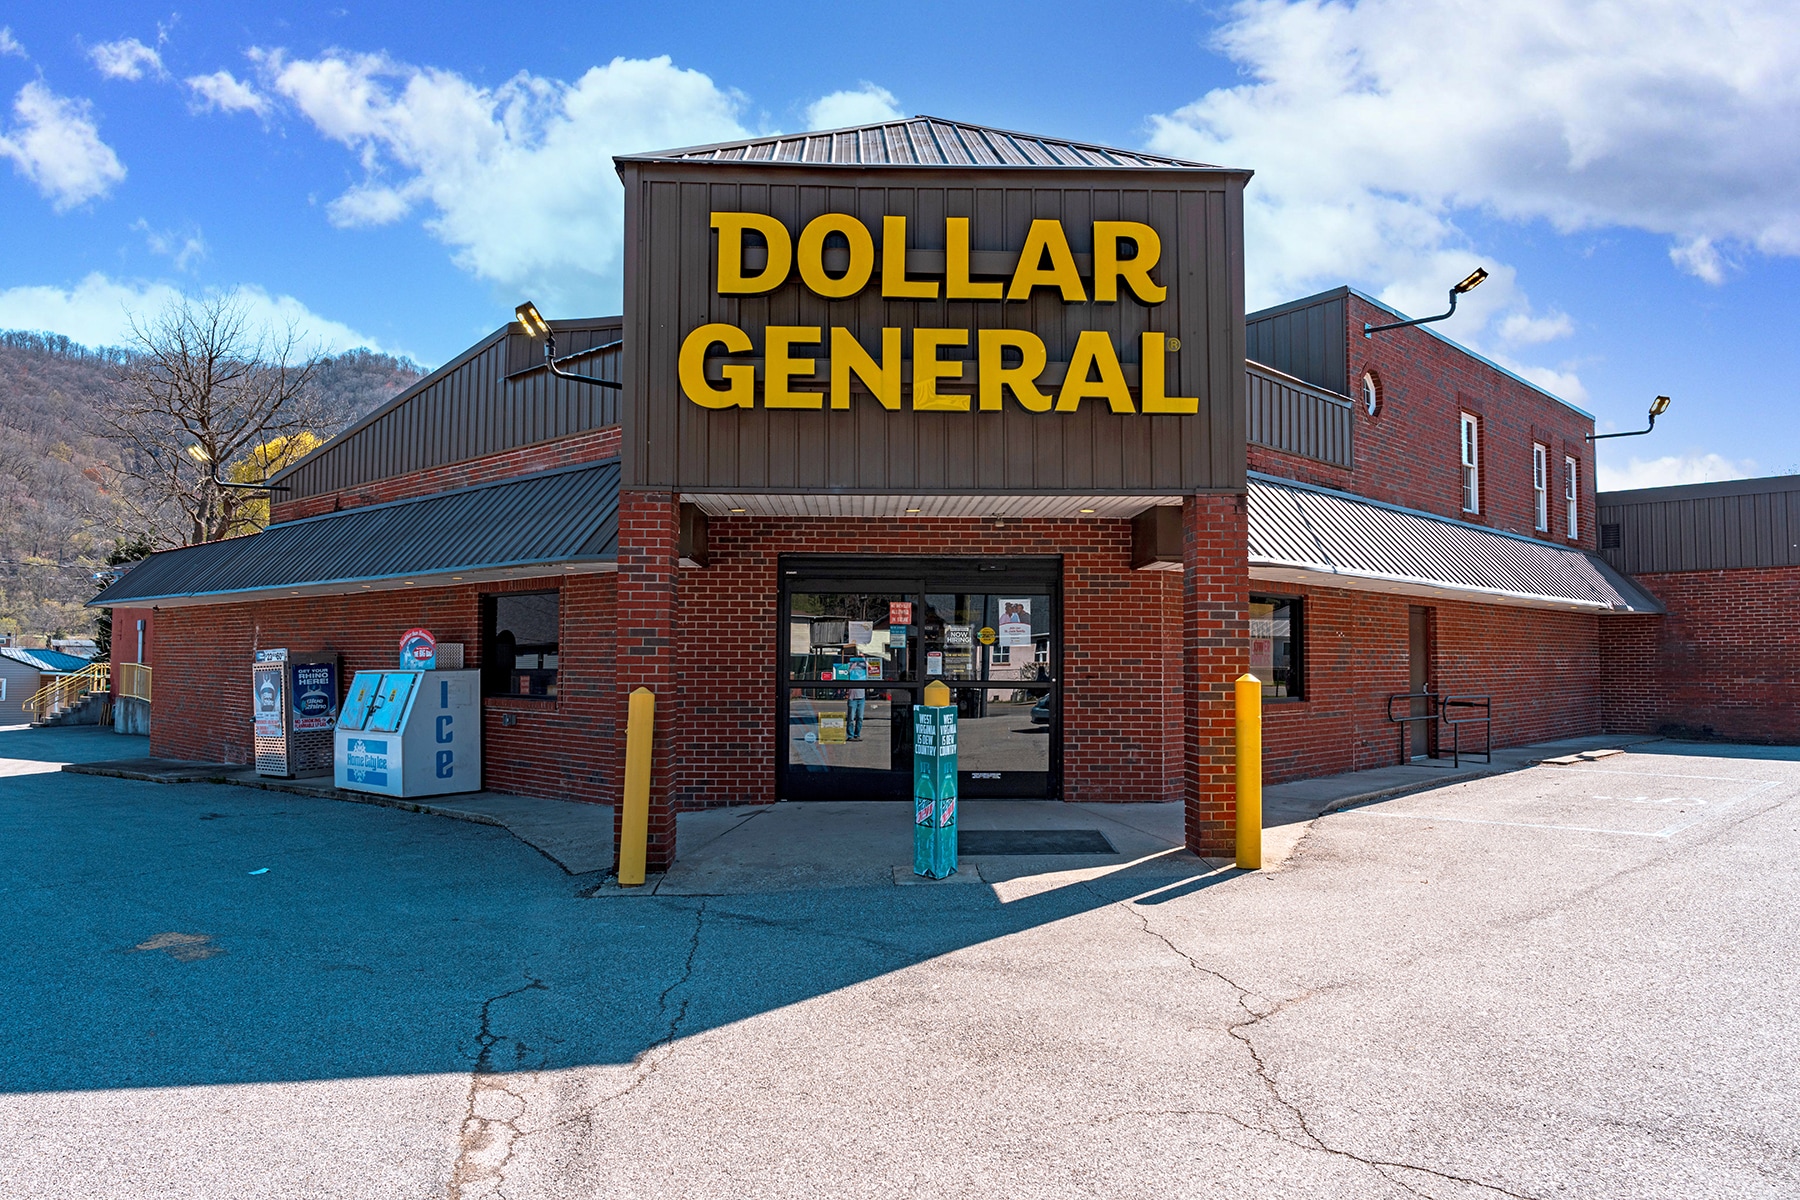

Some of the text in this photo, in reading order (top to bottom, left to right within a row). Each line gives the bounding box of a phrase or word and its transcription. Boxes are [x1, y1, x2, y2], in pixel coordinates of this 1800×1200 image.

[709, 211, 1168, 304] DOLLAR
[677, 322, 1200, 413] GENERAL
[1251, 640, 1271, 653] LOWER
[919, 714, 932, 724] WEST
[943, 714, 954, 724] WEST
[916, 724, 936, 735] VIRGINIA
[940, 724, 956, 735] VIRGINIA
[917, 735, 933, 745] IS DEW
[942, 734, 954, 745] IS DEW
[915, 744, 936, 756] COUNTRY
[940, 744, 957, 756] COUNTRY
[347, 753, 387, 771] Home City Ice
